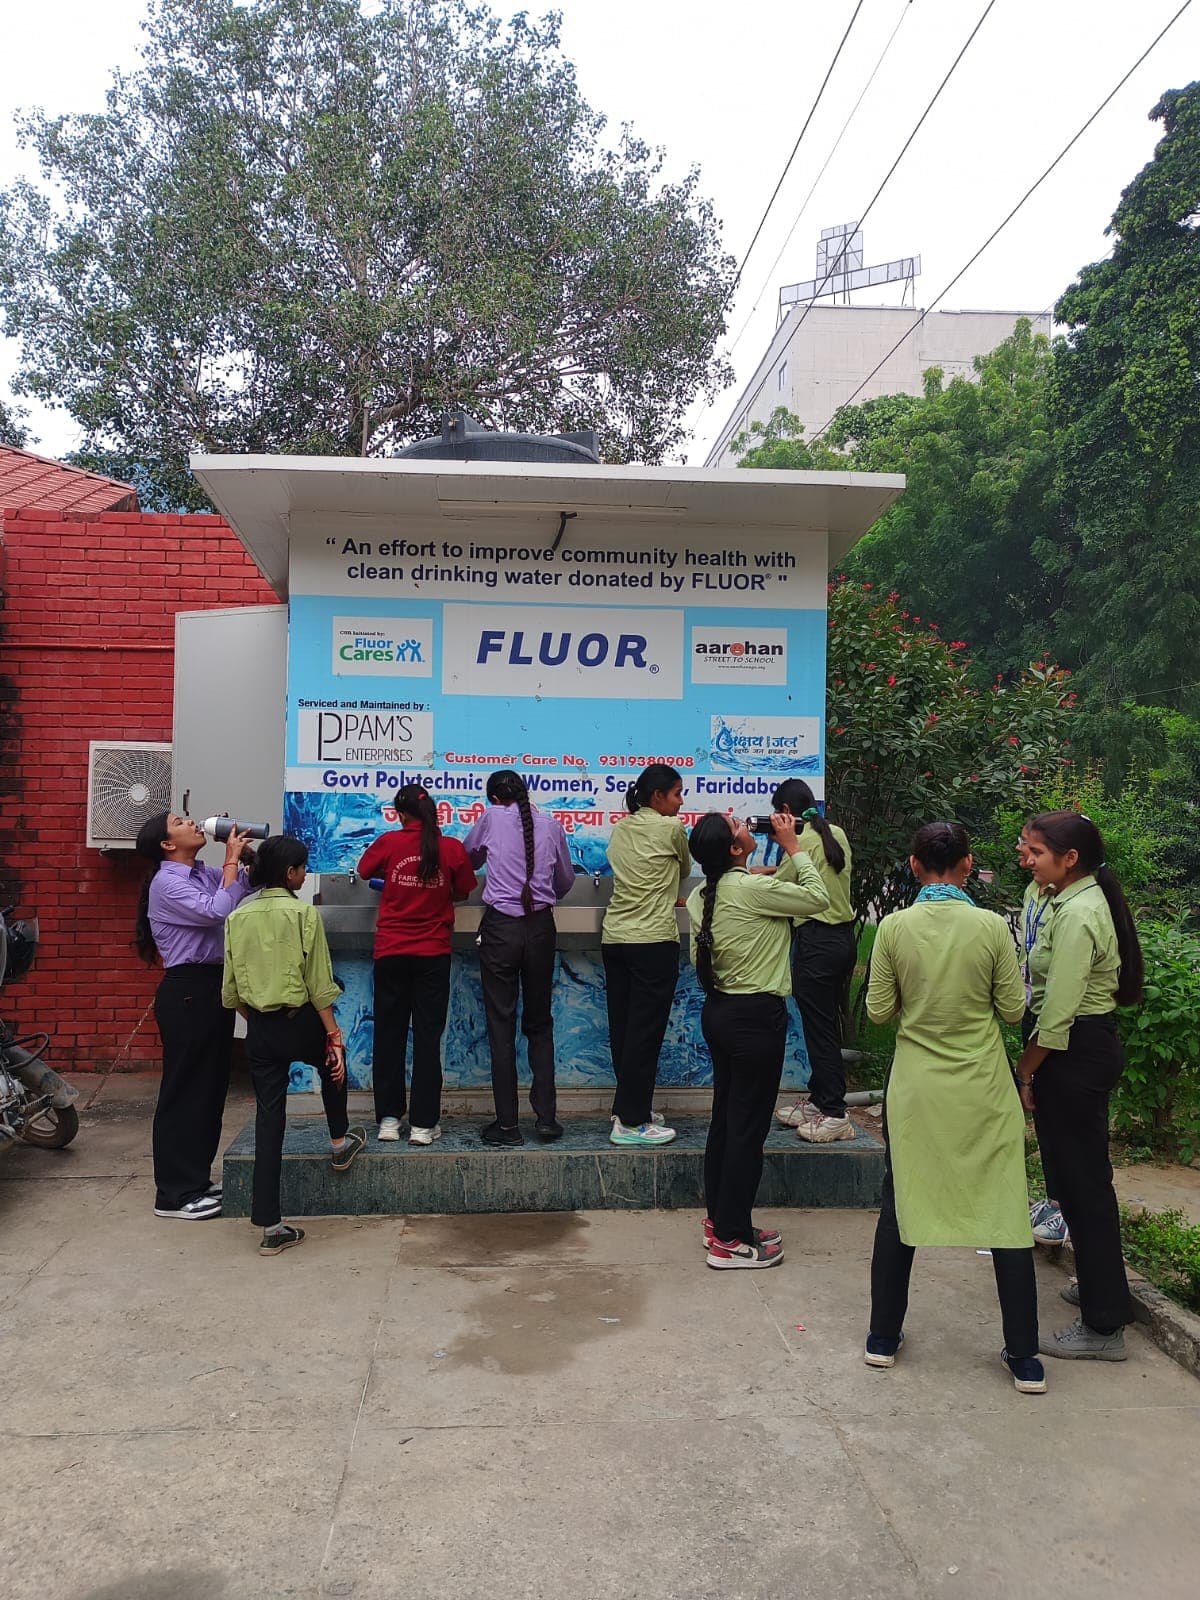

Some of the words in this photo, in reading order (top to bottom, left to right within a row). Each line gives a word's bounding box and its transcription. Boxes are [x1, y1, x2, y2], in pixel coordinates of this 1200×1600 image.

[342, 538, 371, 555] An
[379, 539, 436, 557] effort
[442, 541, 463, 558] to
[469, 543, 554, 563] improve
[561, 548, 677, 568] community
[685, 549, 747, 567] health
[755, 552, 796, 568] with
[347, 563, 404, 580] clean
[411, 565, 498, 587] drinking
[505, 570, 562, 586] water
[568, 570, 653, 589] donated
[660, 574, 685, 592] by
[355, 638, 393, 649] Fluor
[695, 641, 783, 656] aarohan
[339, 645, 394, 661] Cares
[298, 699, 337, 709] Serviced
[340, 700, 358, 709] and
[360, 700, 410, 710] Maintained
[413, 701, 424, 711] by
[345, 714, 413, 742] PAM'S
[346, 748, 413, 762] ENTERPRISES
[445, 752, 518, 765] Customer
[522, 754, 558, 766] Care
[562, 756, 588, 766] No.
[600, 755, 694, 767] 9319380908
[323, 770, 369, 788] Govt
[376, 770, 482, 790] Polytechnic
[522, 774, 598, 795] Women,
